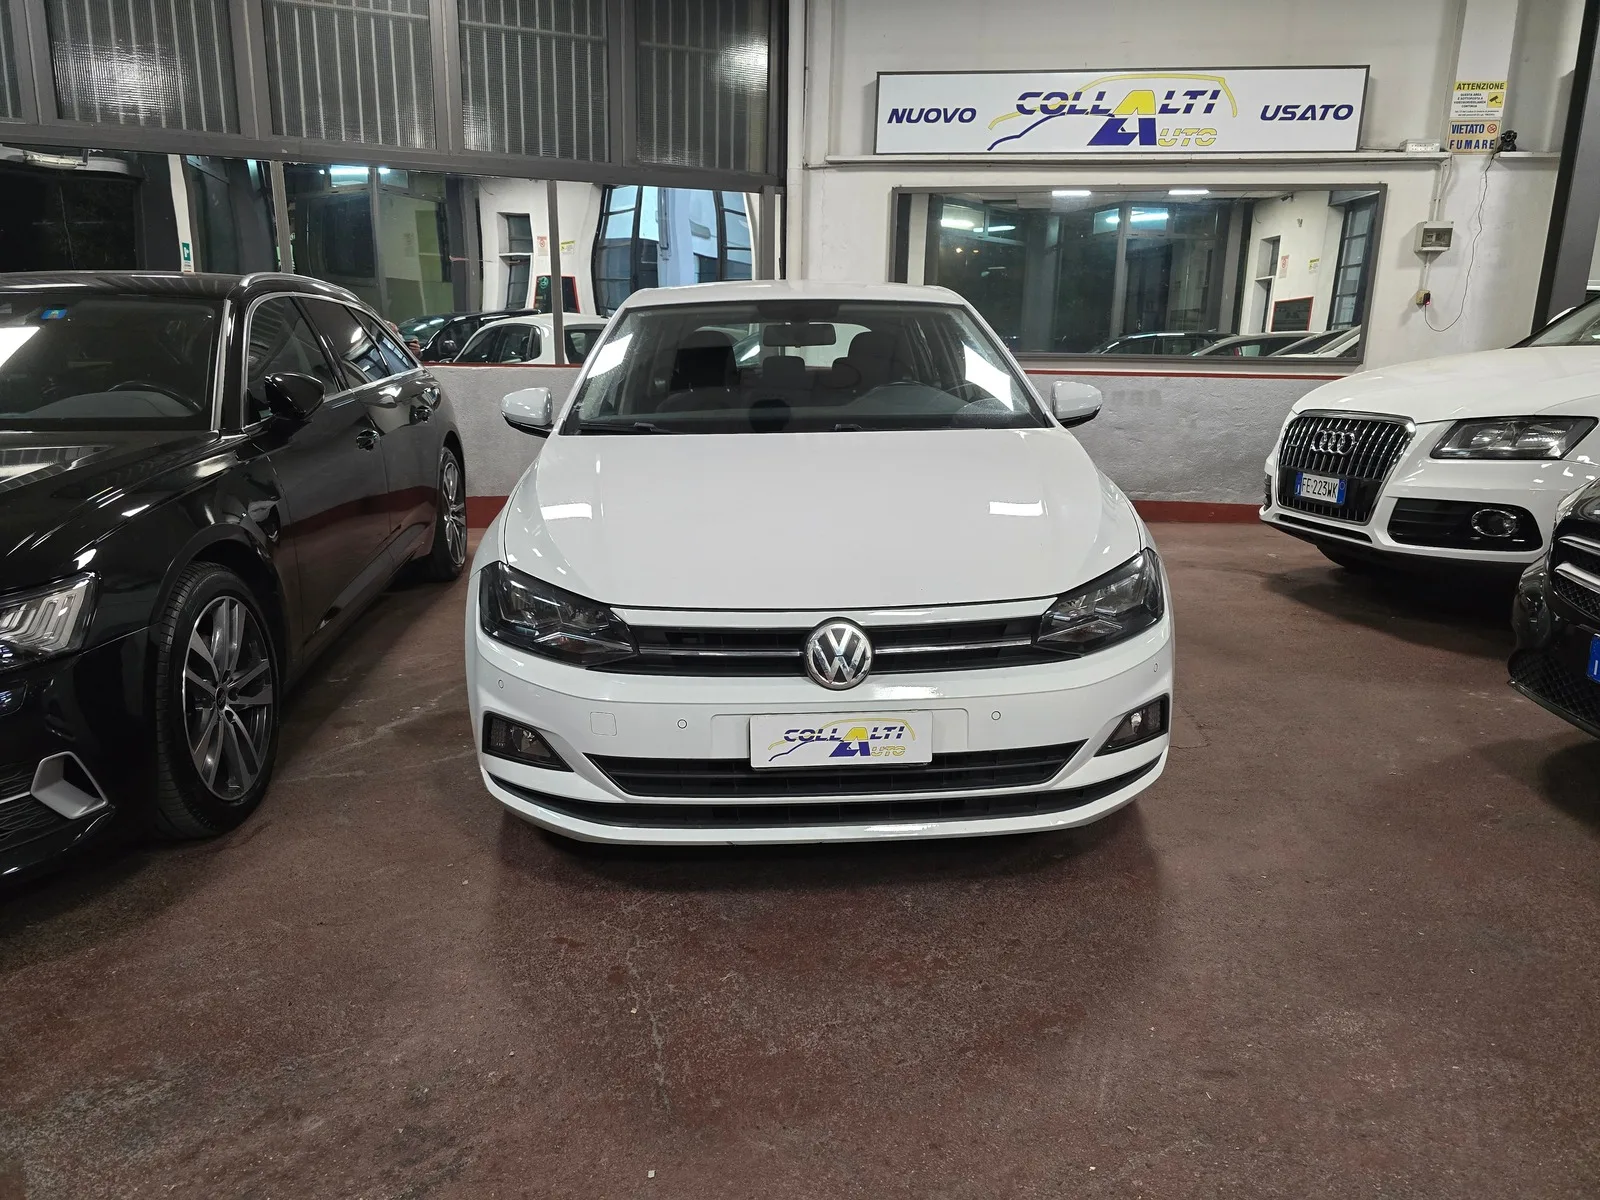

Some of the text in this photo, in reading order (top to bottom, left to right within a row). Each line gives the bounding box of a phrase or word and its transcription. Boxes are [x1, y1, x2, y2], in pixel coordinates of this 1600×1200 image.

[886, 107, 977, 125] NUOVO
[1259, 103, 1354, 122] USATO
[1452, 124, 1485, 134] VIETATO
[1449, 139, 1495, 150] FUMARE
